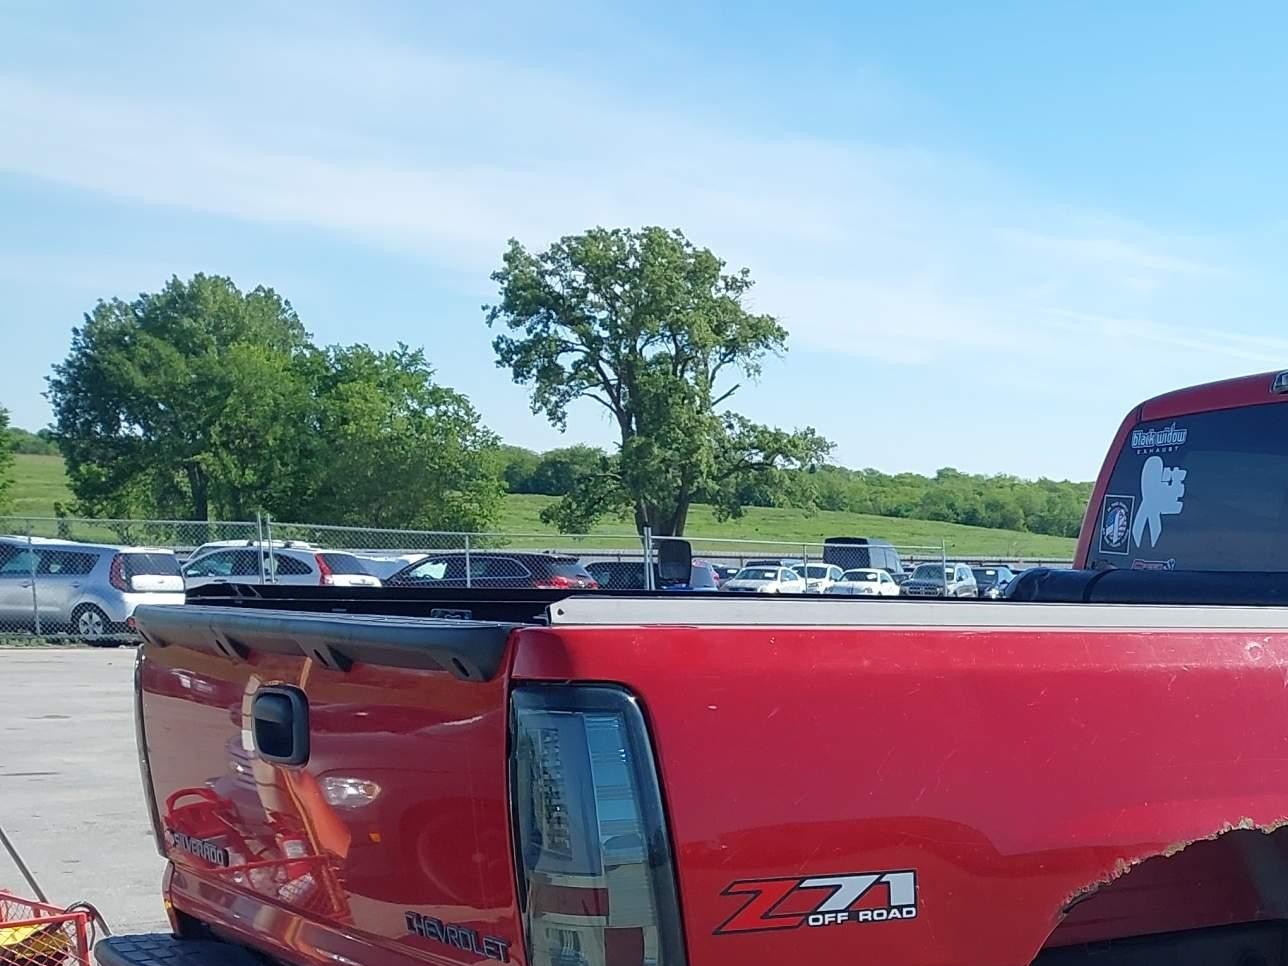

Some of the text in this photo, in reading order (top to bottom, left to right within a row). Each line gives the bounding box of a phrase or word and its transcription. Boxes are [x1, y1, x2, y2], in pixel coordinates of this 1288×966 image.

[712, 869, 917, 935] Z71
[808, 906, 917, 927] OFF ROAD
[405, 911, 511, 963] CHEVROLET
